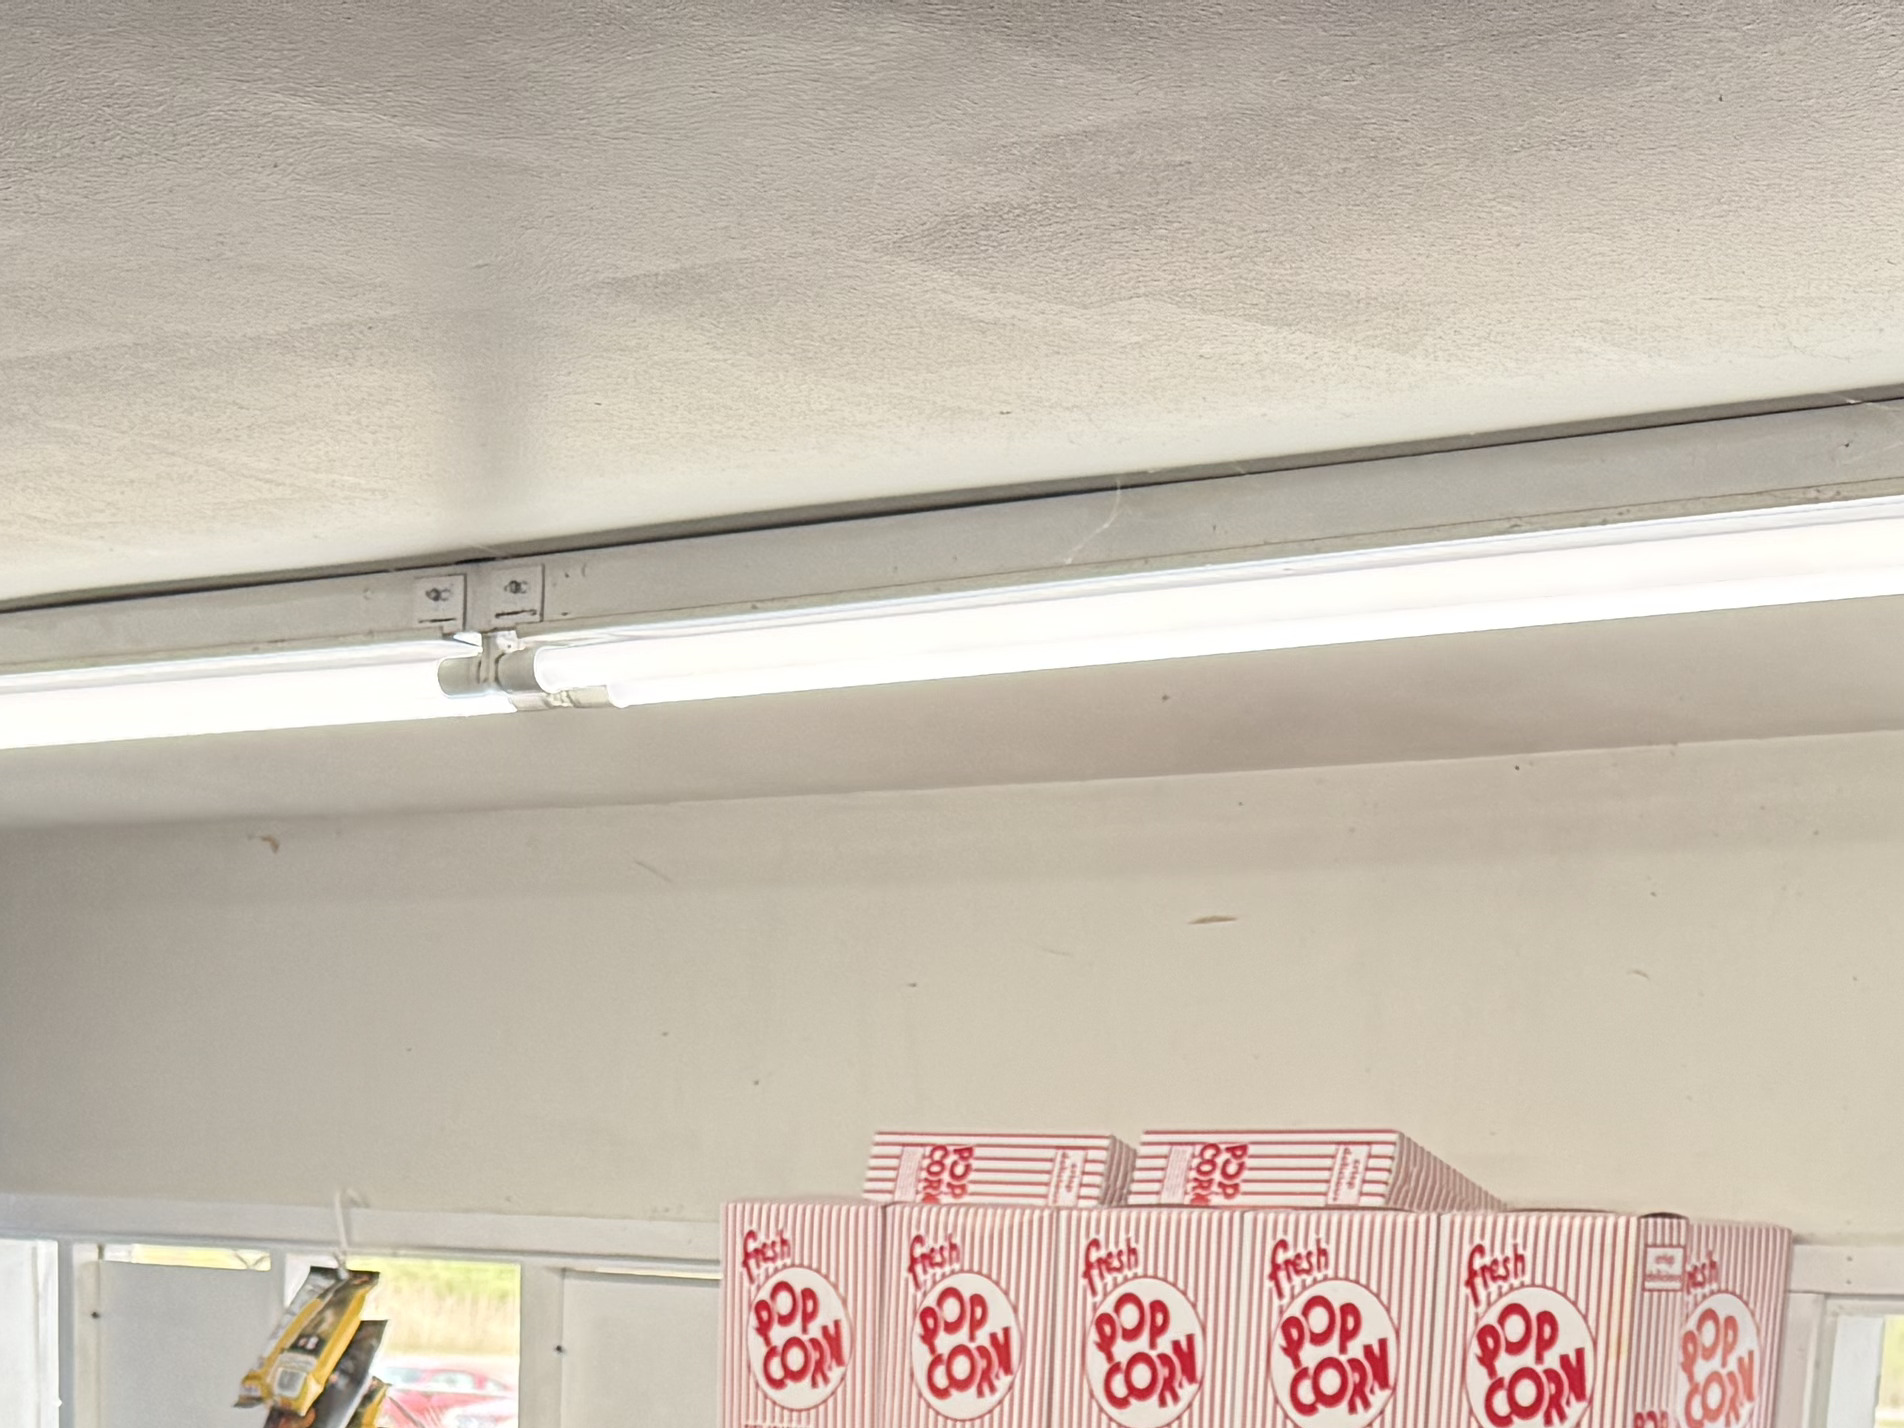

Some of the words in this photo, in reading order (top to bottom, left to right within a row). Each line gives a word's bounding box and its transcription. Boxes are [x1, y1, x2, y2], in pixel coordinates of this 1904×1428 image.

[742, 1230, 790, 1284] fresh
[908, 1234, 960, 1290] fresh
[1082, 1237, 1139, 1298] fresh
[1268, 1238, 1329, 1300] fresh
[1465, 1244, 1526, 1307] fresh
[754, 1280, 819, 1347] POP
[919, 1286, 988, 1356] POP
[1094, 1293, 1170, 1365] POP
[1280, 1295, 1362, 1369] POP
[1476, 1303, 1559, 1379] POP
[1681, 1308, 1739, 1386] POP
[763, 1319, 845, 1389] CORN
[927, 1327, 1013, 1399] CORN
[1104, 1334, 1199, 1409] CORN
[1290, 1338, 1391, 1416] CORN
[1485, 1347, 1586, 1428] CORN
